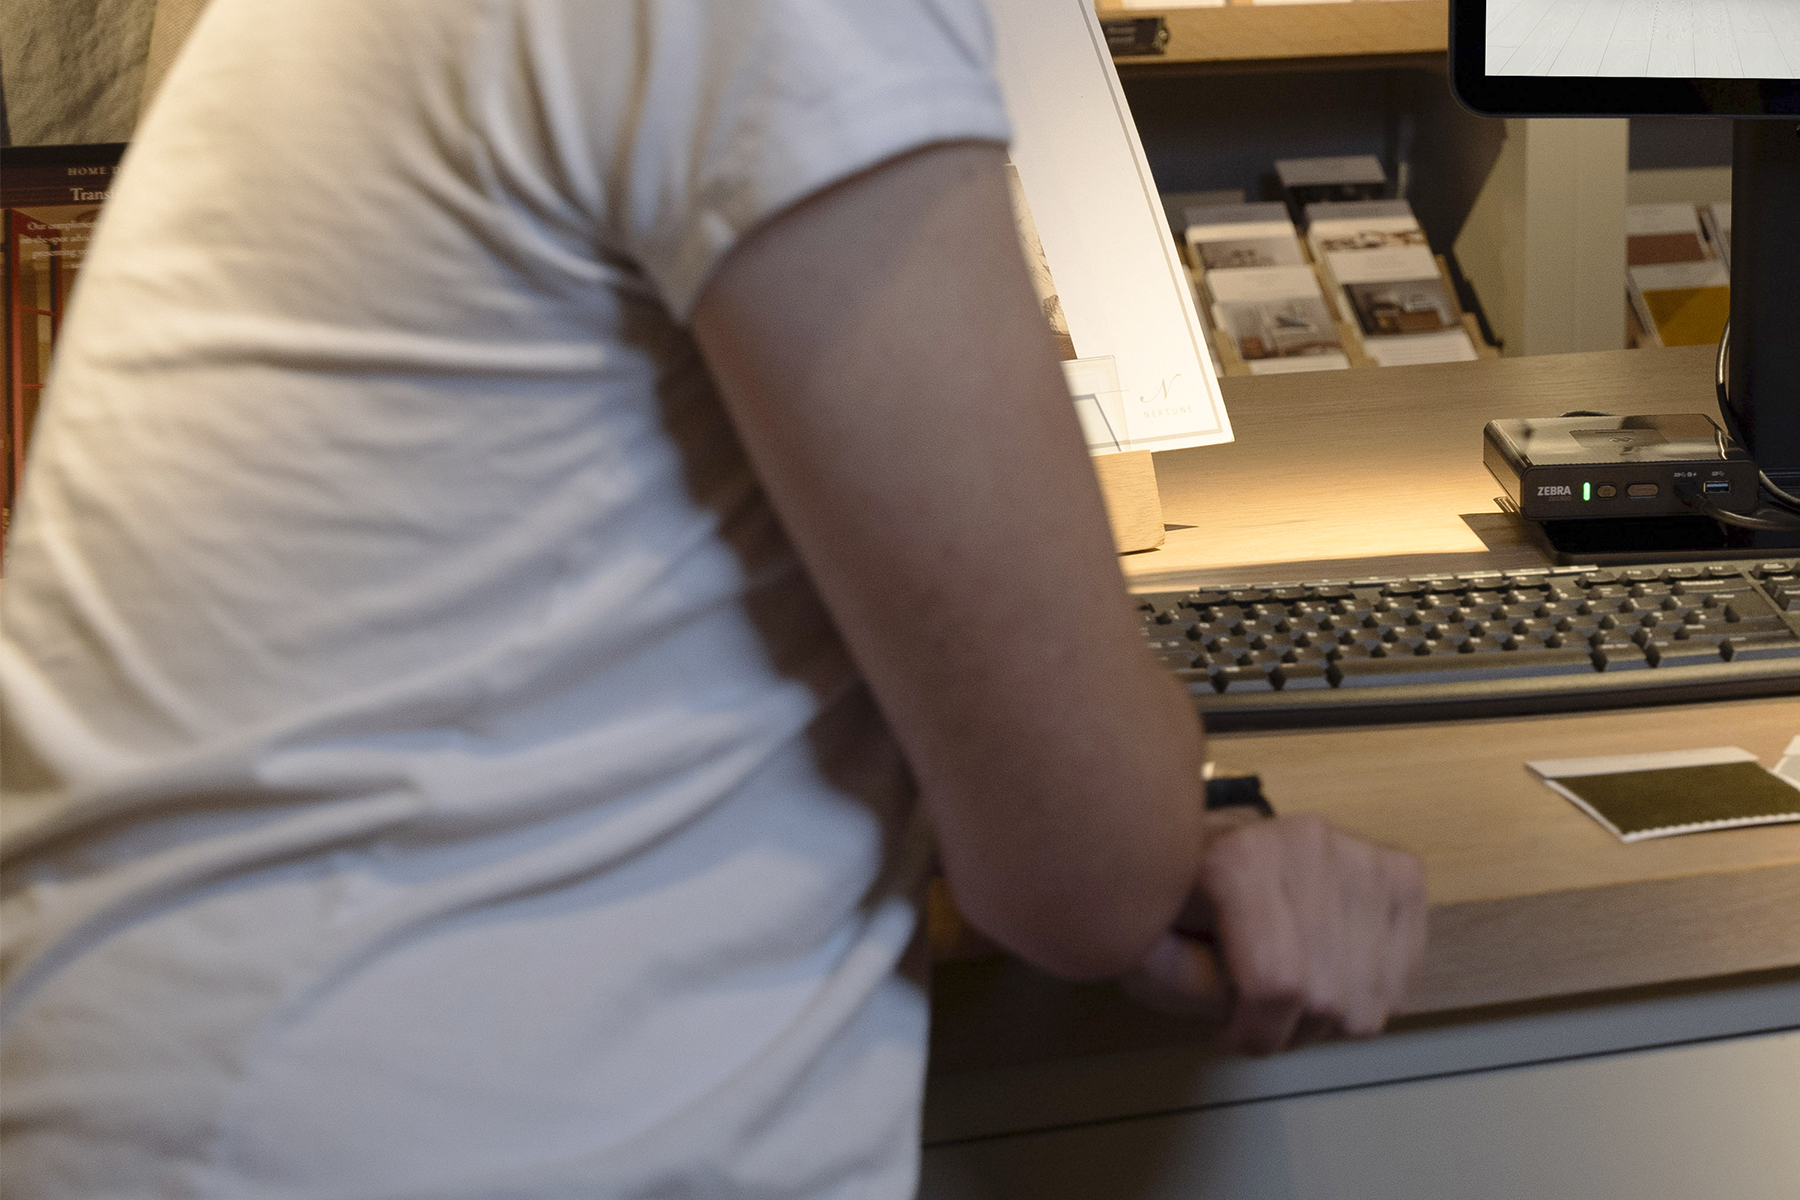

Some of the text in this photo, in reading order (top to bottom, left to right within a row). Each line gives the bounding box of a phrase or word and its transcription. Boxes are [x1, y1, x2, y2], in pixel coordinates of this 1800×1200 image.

[67, 166, 108, 176] HOME
[70, 187, 112, 202] Trans
[1143, 405, 1193, 419] NEPTUNE
[1537, 485, 1572, 496] ZEBRA
